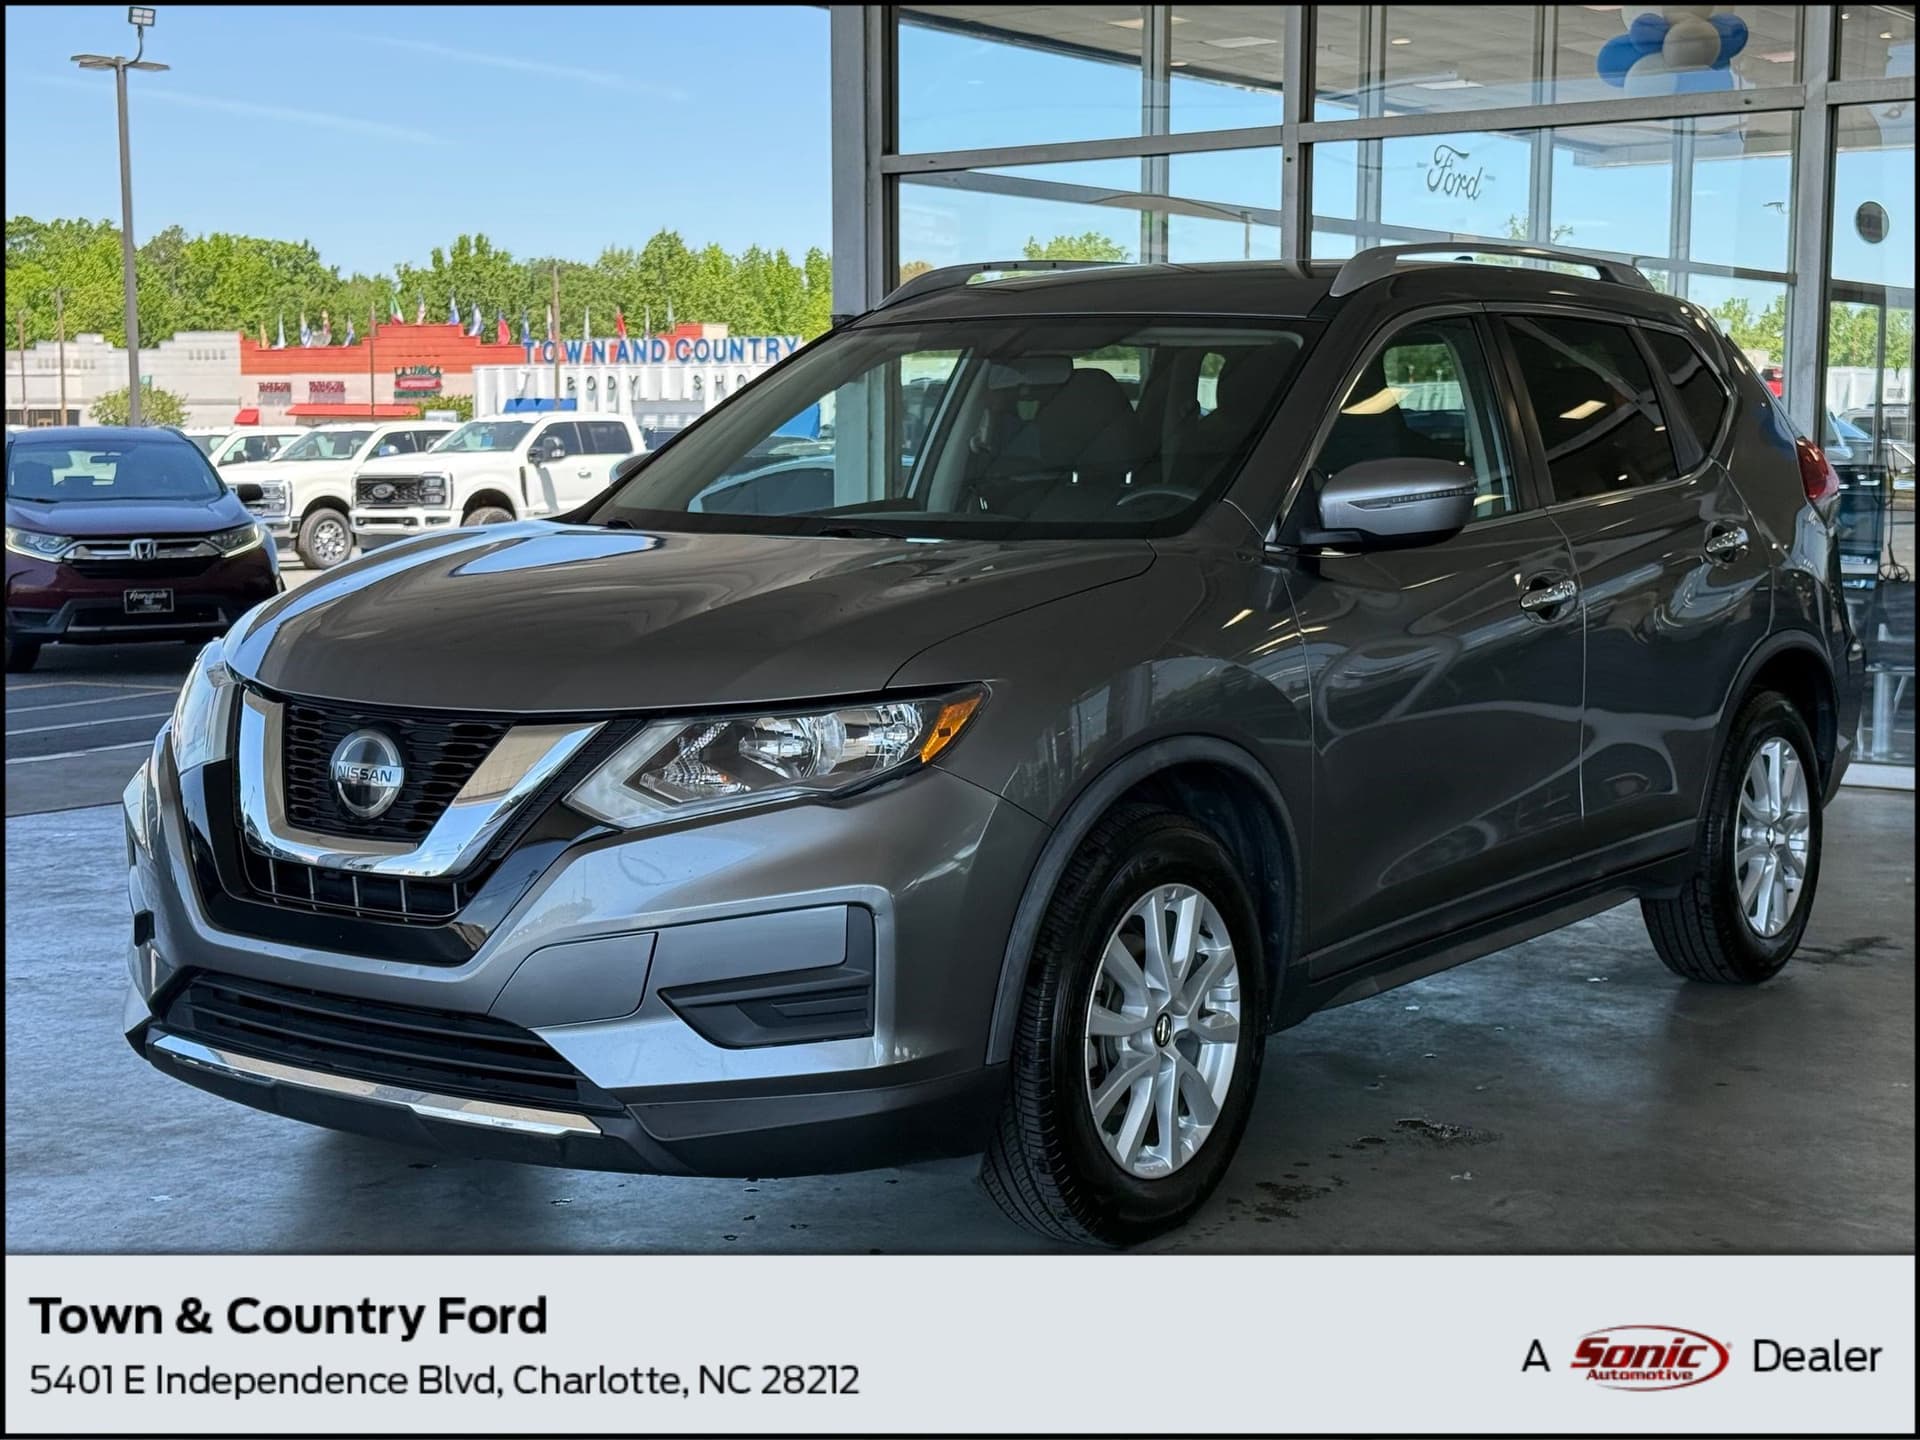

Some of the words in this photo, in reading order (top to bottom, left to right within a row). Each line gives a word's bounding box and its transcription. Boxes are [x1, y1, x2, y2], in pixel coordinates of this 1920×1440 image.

[1427, 144, 1483, 200] Ford
[522, 340, 605, 364] TOWN
[616, 339, 665, 363] AND
[675, 338, 799, 363] COUNTRY
[566, 375, 640, 393] BODY
[692, 374, 747, 392] SHO
[336, 766, 392, 783] NISSAN
